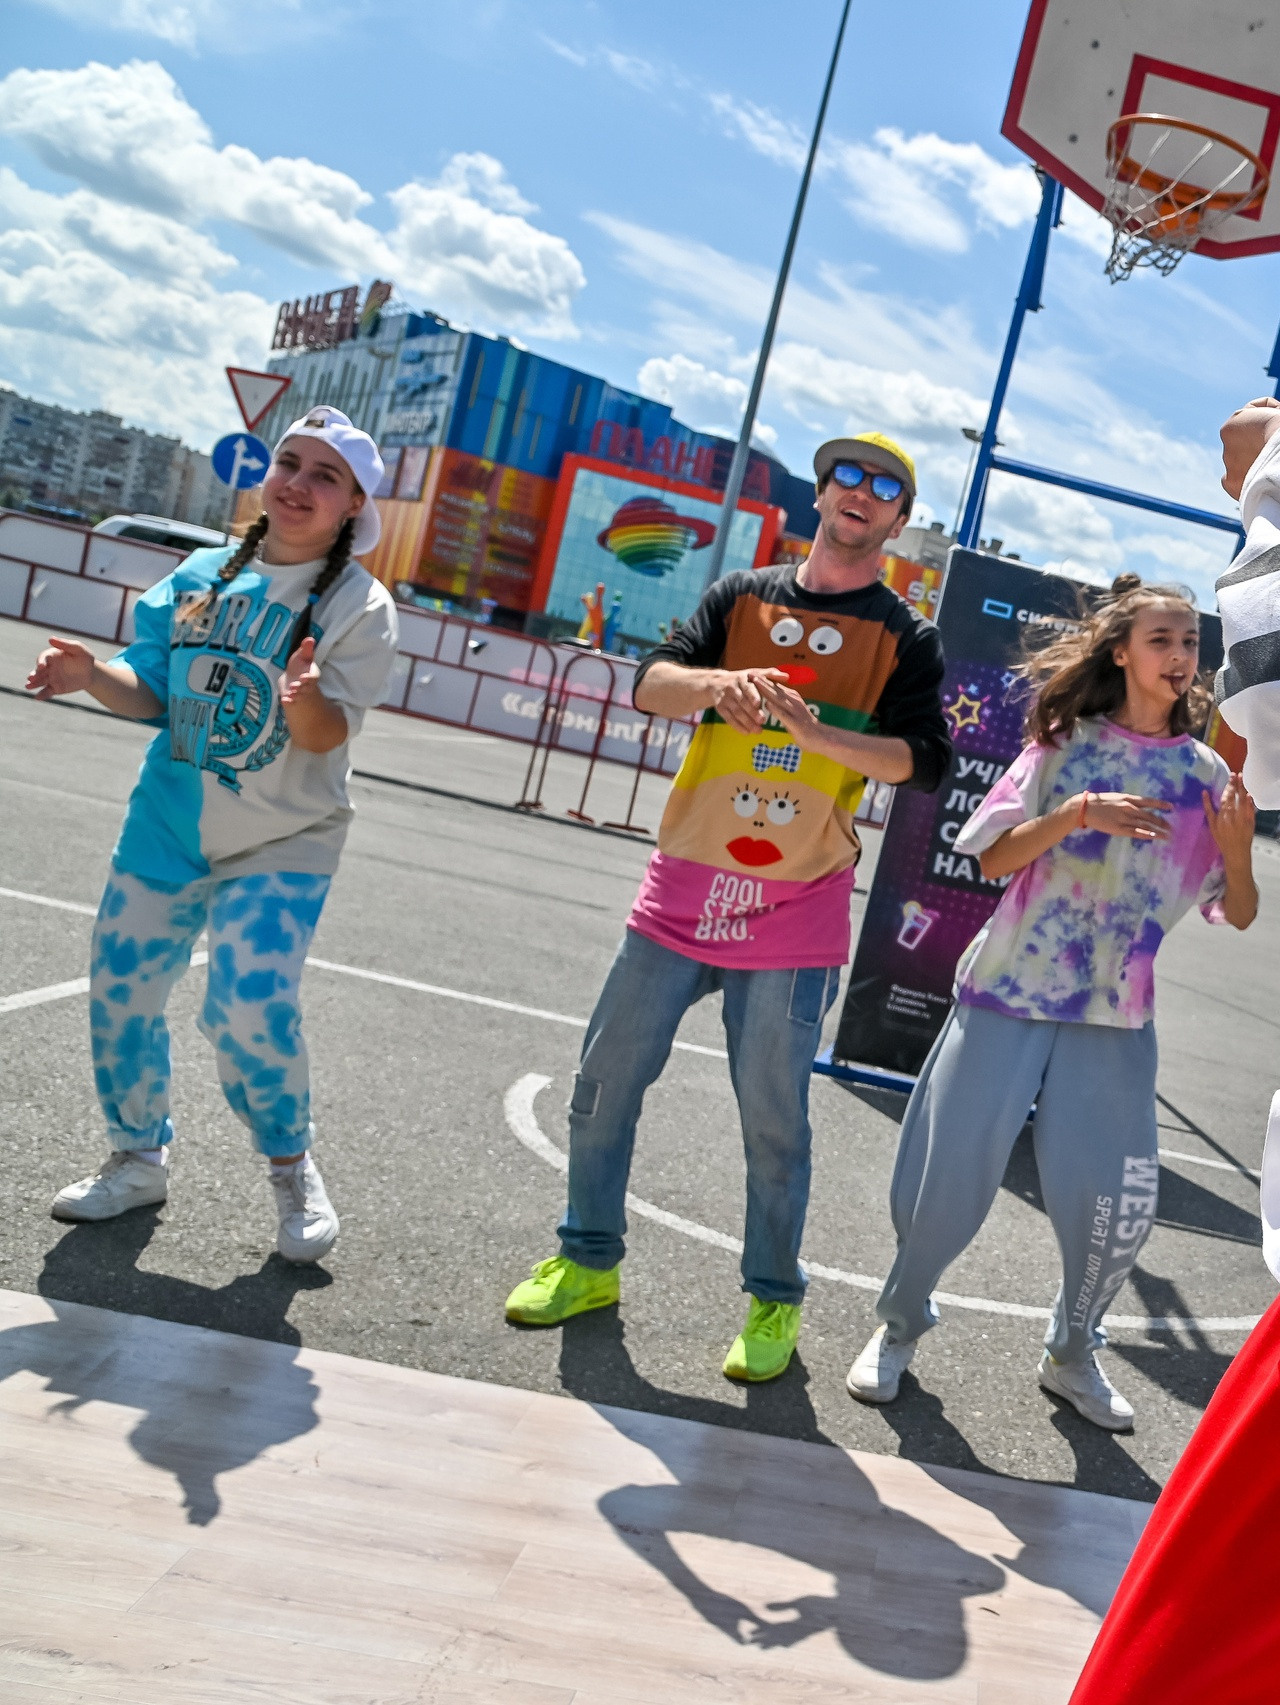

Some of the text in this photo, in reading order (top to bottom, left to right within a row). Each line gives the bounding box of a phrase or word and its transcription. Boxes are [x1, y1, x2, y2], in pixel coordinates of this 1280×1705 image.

[589, 419, 771, 502] ПЛАНЕА
[933, 852, 974, 882] НА
[708, 872, 770, 908] COOL
[695, 914, 755, 942] BRO.
[1091, 1195, 1113, 1250] SPORT
